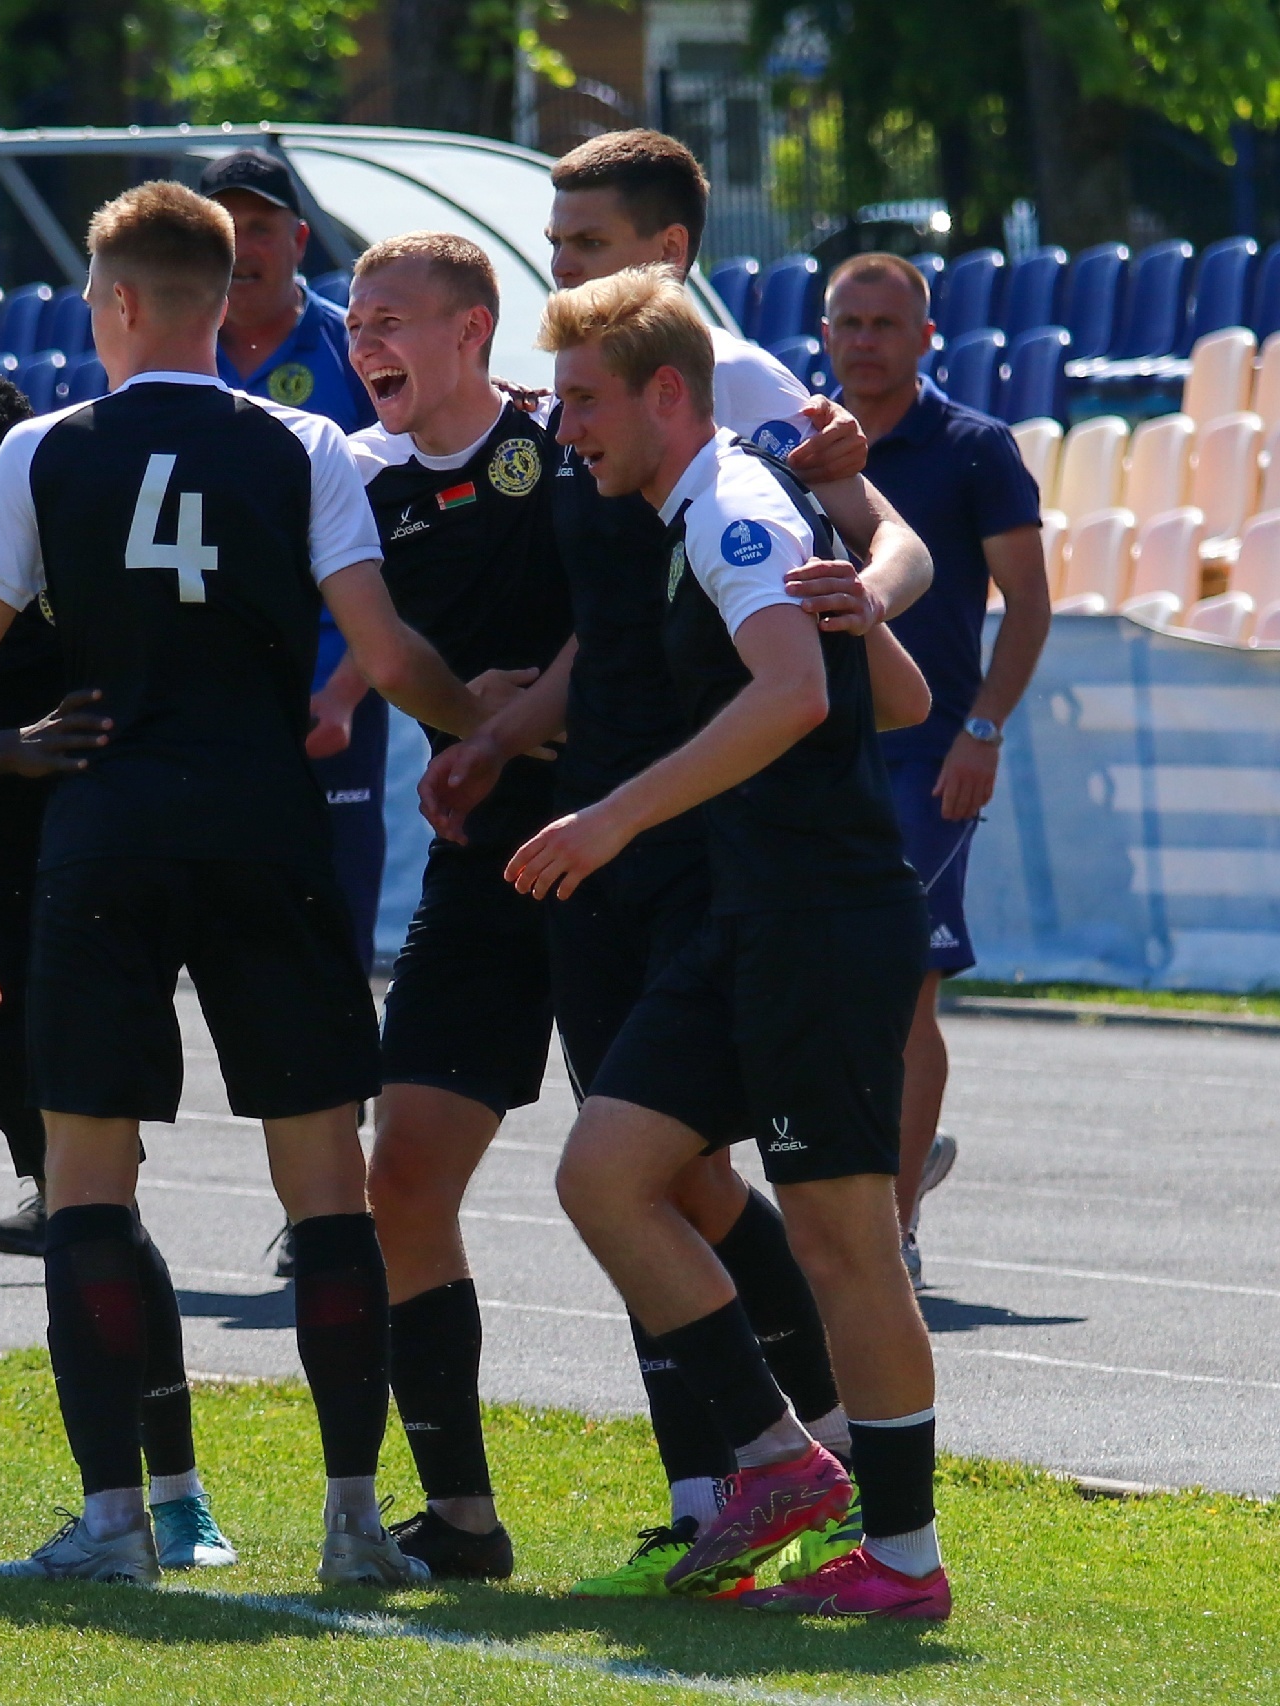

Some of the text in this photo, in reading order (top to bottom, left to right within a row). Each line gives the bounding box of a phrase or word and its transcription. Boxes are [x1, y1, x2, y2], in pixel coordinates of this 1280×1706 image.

[125, 454, 218, 603] 4
[390, 520, 430, 540] JÖGEL
[733, 542, 764, 558] ПЕРВАЯ
[741, 551, 762, 562] ЛИГА
[768, 1140, 808, 1152] JÖGEL
[640, 1358, 677, 1372] ÖGE
[405, 1422, 441, 1432] GEL
